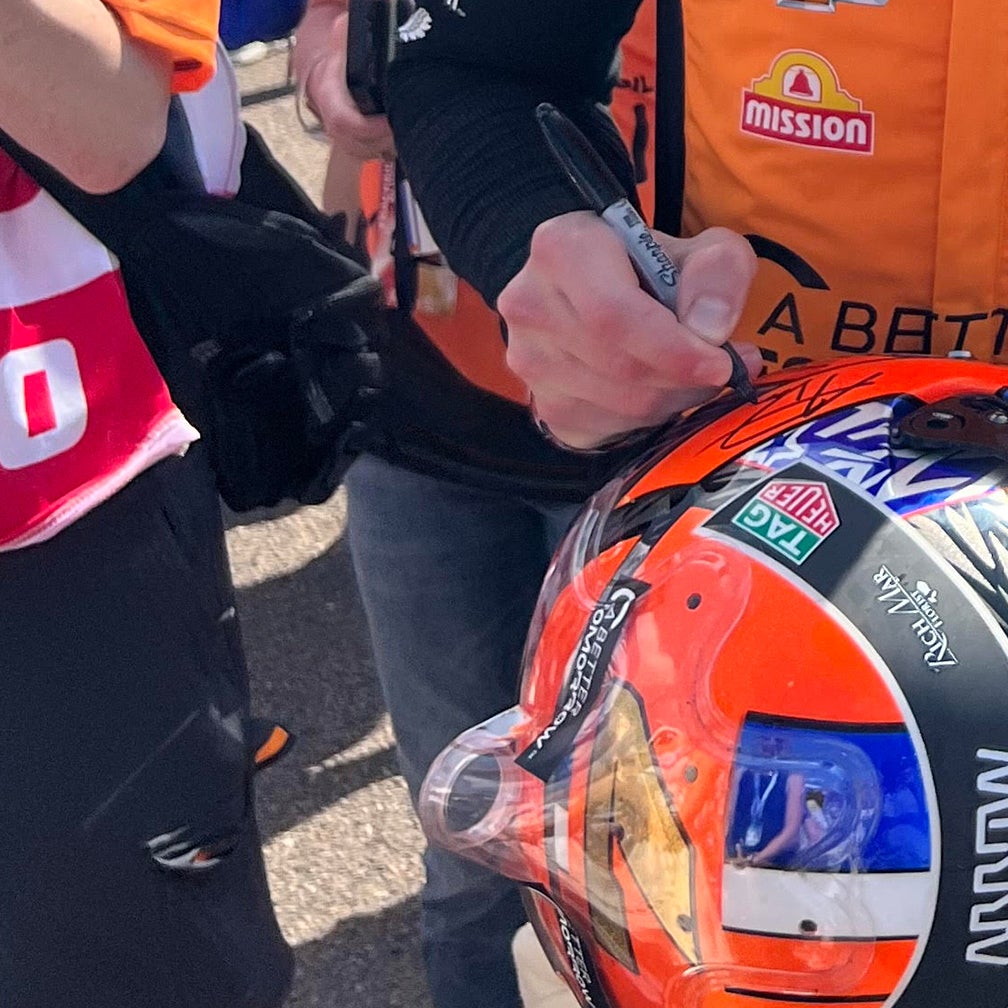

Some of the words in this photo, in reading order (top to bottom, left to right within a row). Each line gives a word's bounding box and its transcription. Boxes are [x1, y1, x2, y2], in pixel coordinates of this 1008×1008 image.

[757, 292, 806, 345] A
[743, 503, 808, 557] TAG
[763, 485, 835, 535] HEUER
[872, 564, 921, 614] MAR
[570, 625, 609, 718] BETTER
[911, 618, 958, 672] RICH
